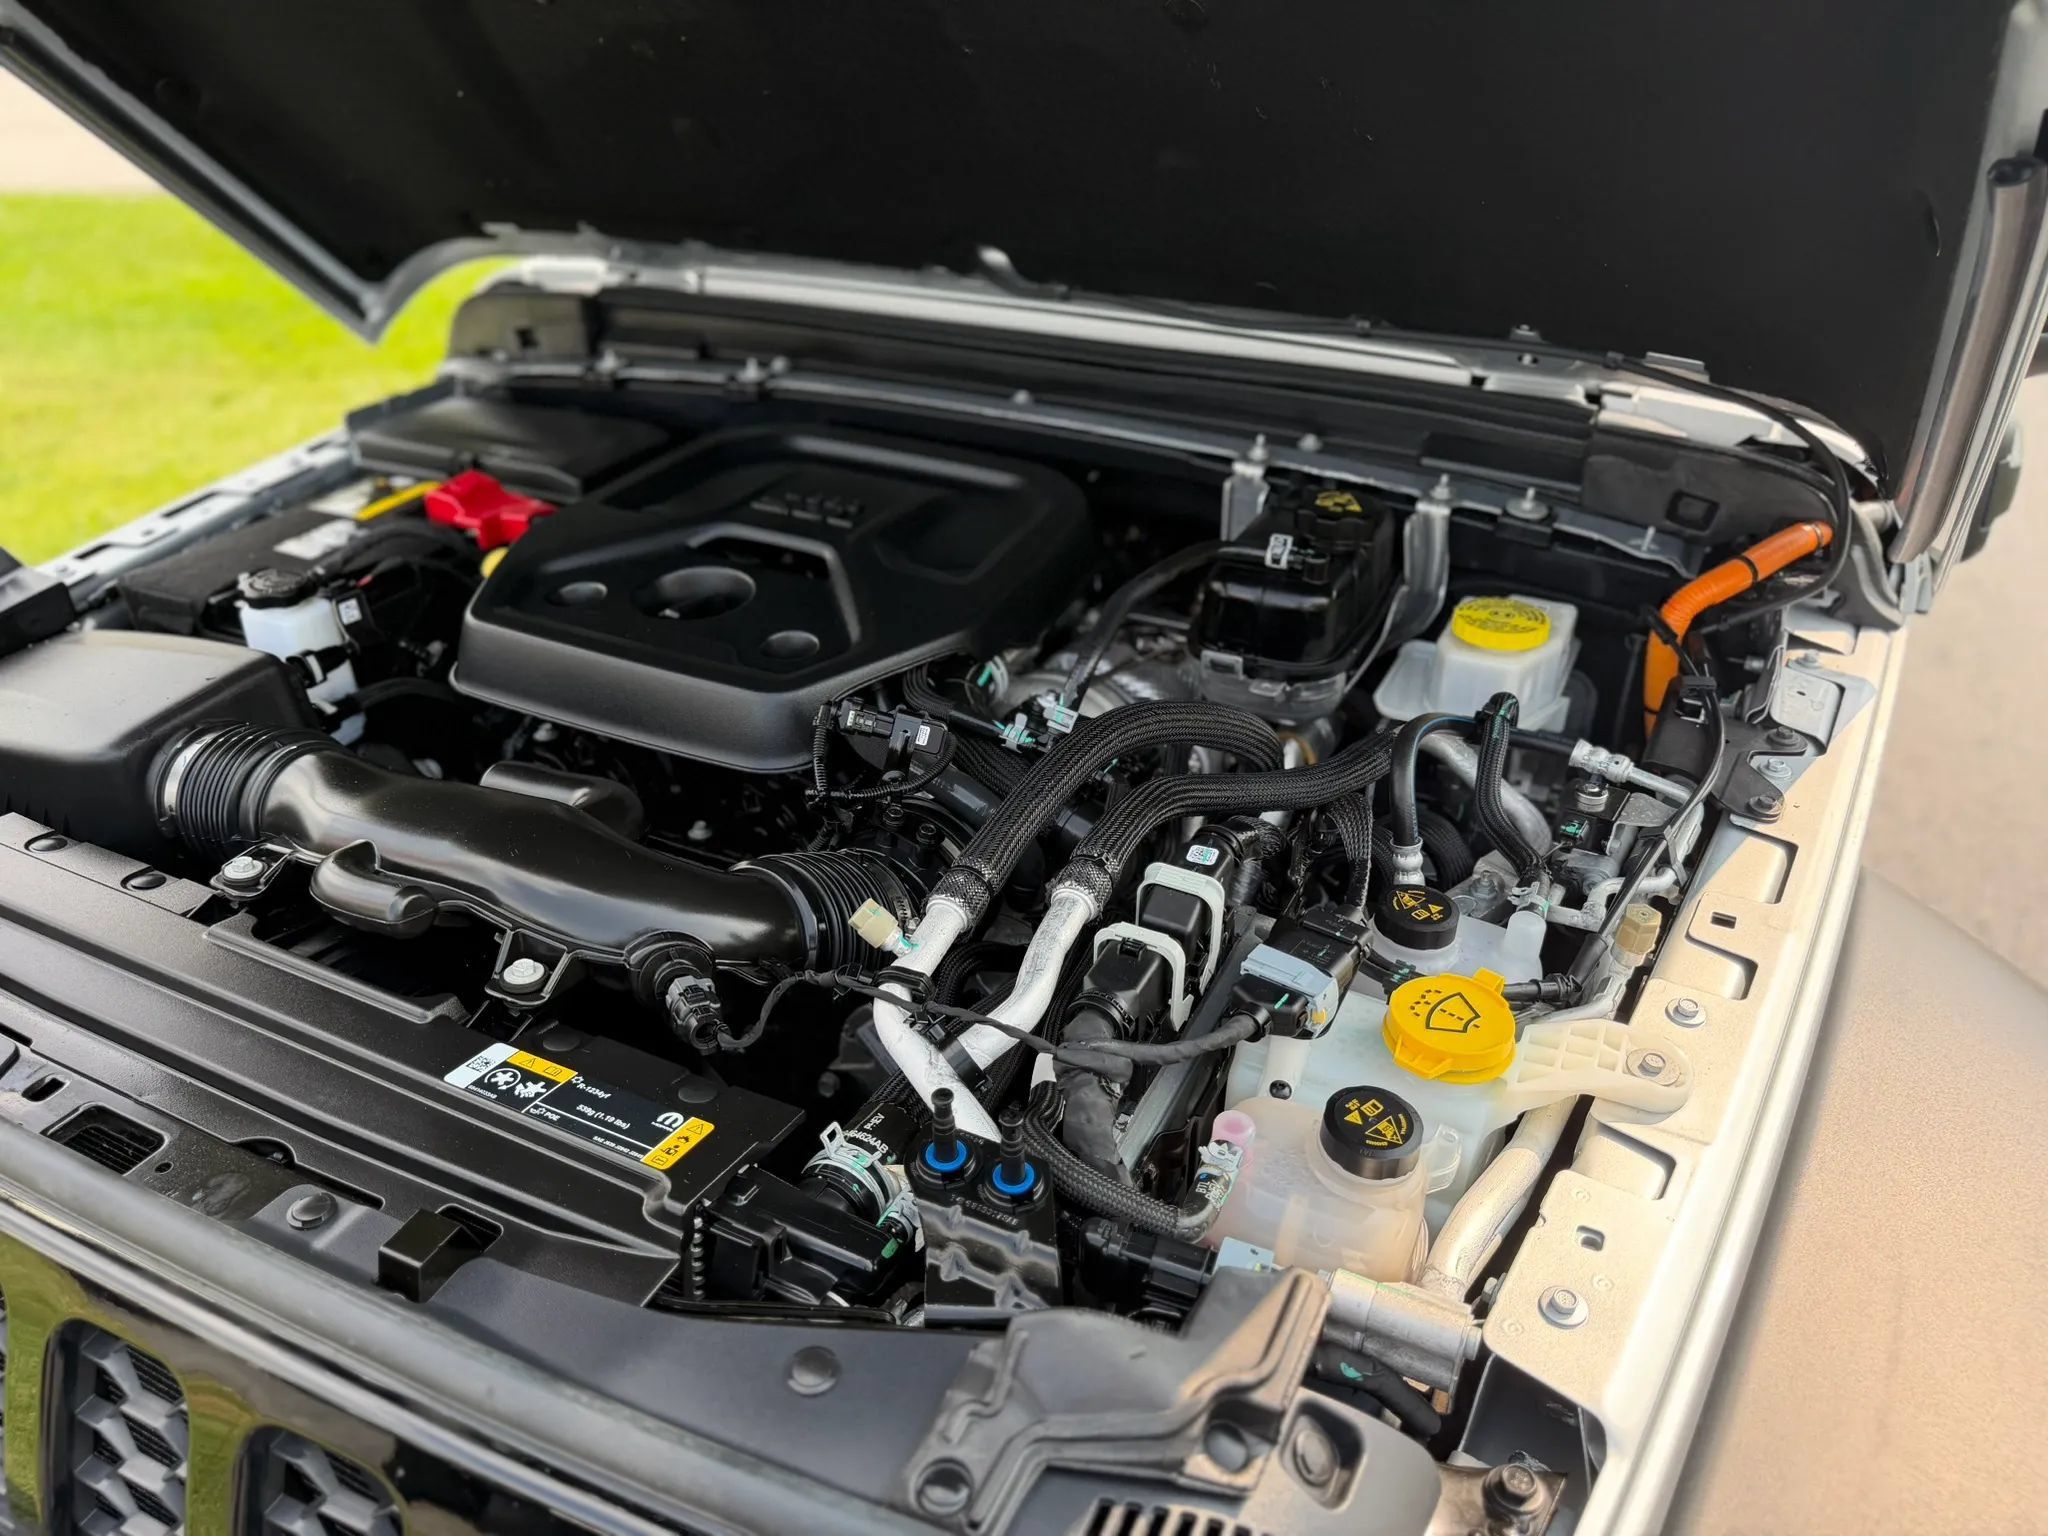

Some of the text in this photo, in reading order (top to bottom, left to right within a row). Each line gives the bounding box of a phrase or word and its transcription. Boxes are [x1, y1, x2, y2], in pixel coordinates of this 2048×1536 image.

[577, 1082, 612, 1099] R-1234yf
[543, 1111, 561, 1122] POE
[863, 1112, 885, 1131] PHEV
[613, 1118, 631, 1130] lbs)
[1195, 1181, 1210, 1194] BTL
